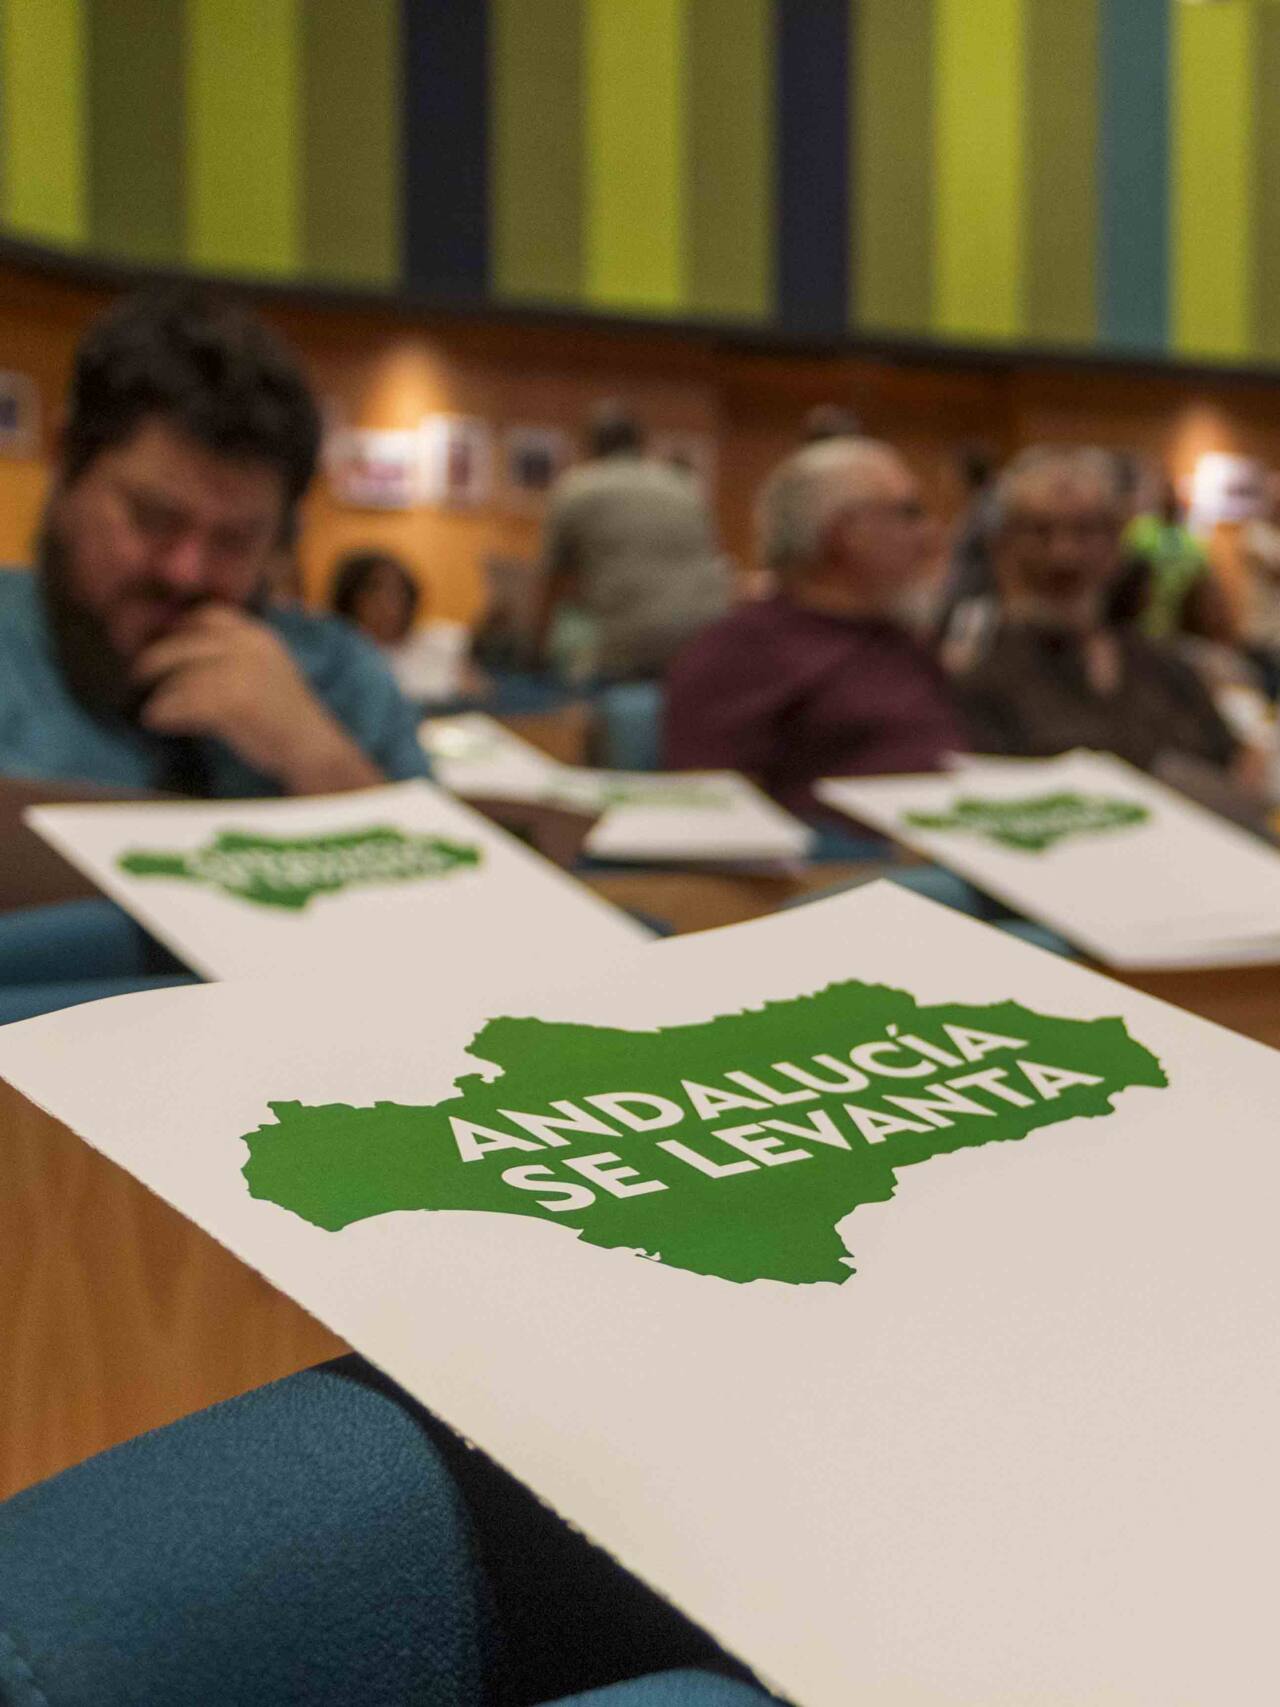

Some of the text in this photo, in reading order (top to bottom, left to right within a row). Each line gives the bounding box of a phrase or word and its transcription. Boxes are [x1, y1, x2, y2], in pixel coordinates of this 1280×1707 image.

[447, 1022, 1029, 1163] ANDALUCÍA
[501, 1059, 1105, 1213] SE LEVANTA
